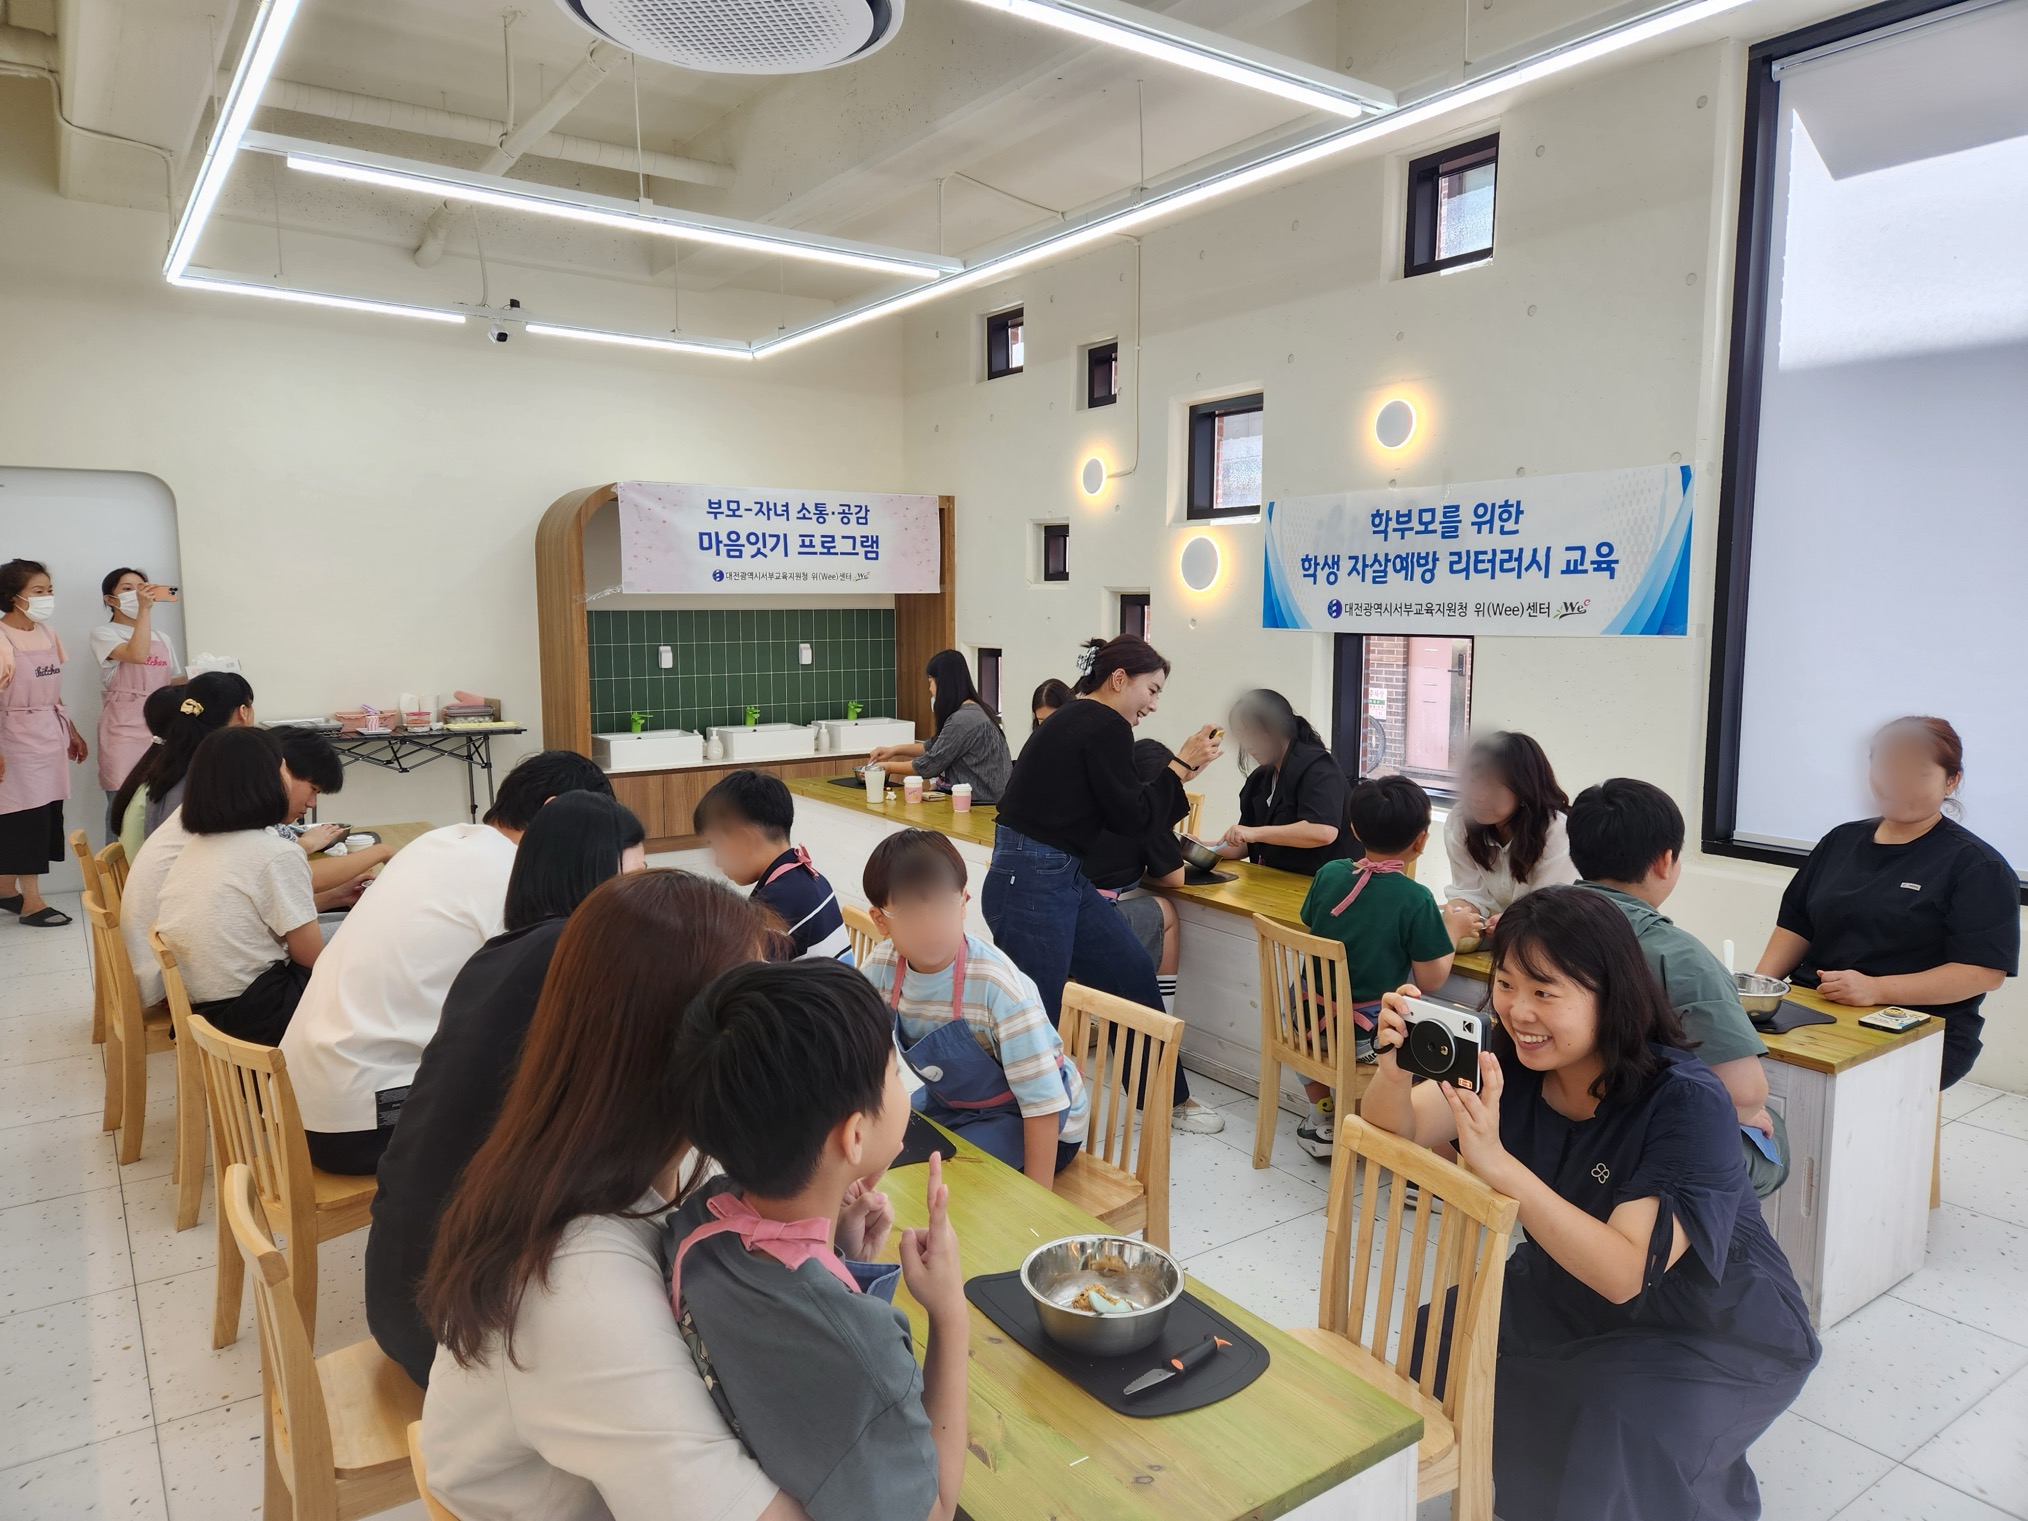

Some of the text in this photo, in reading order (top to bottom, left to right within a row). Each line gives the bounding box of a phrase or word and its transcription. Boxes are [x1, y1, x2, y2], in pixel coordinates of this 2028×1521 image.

[706, 499, 870, 525] 부모-자녀 소통·공감
[1370, 499, 1525, 541] 학부모를 위한
[698, 530, 880, 561] 마음잇기 프로그램
[725, 571, 808, 581] 대전광역시서부교육지원청
[1300, 541, 1620, 586] 학생 자살예방 리터러시 교육
[1344, 601, 1468, 618] 대전광역시서부교육지원청
